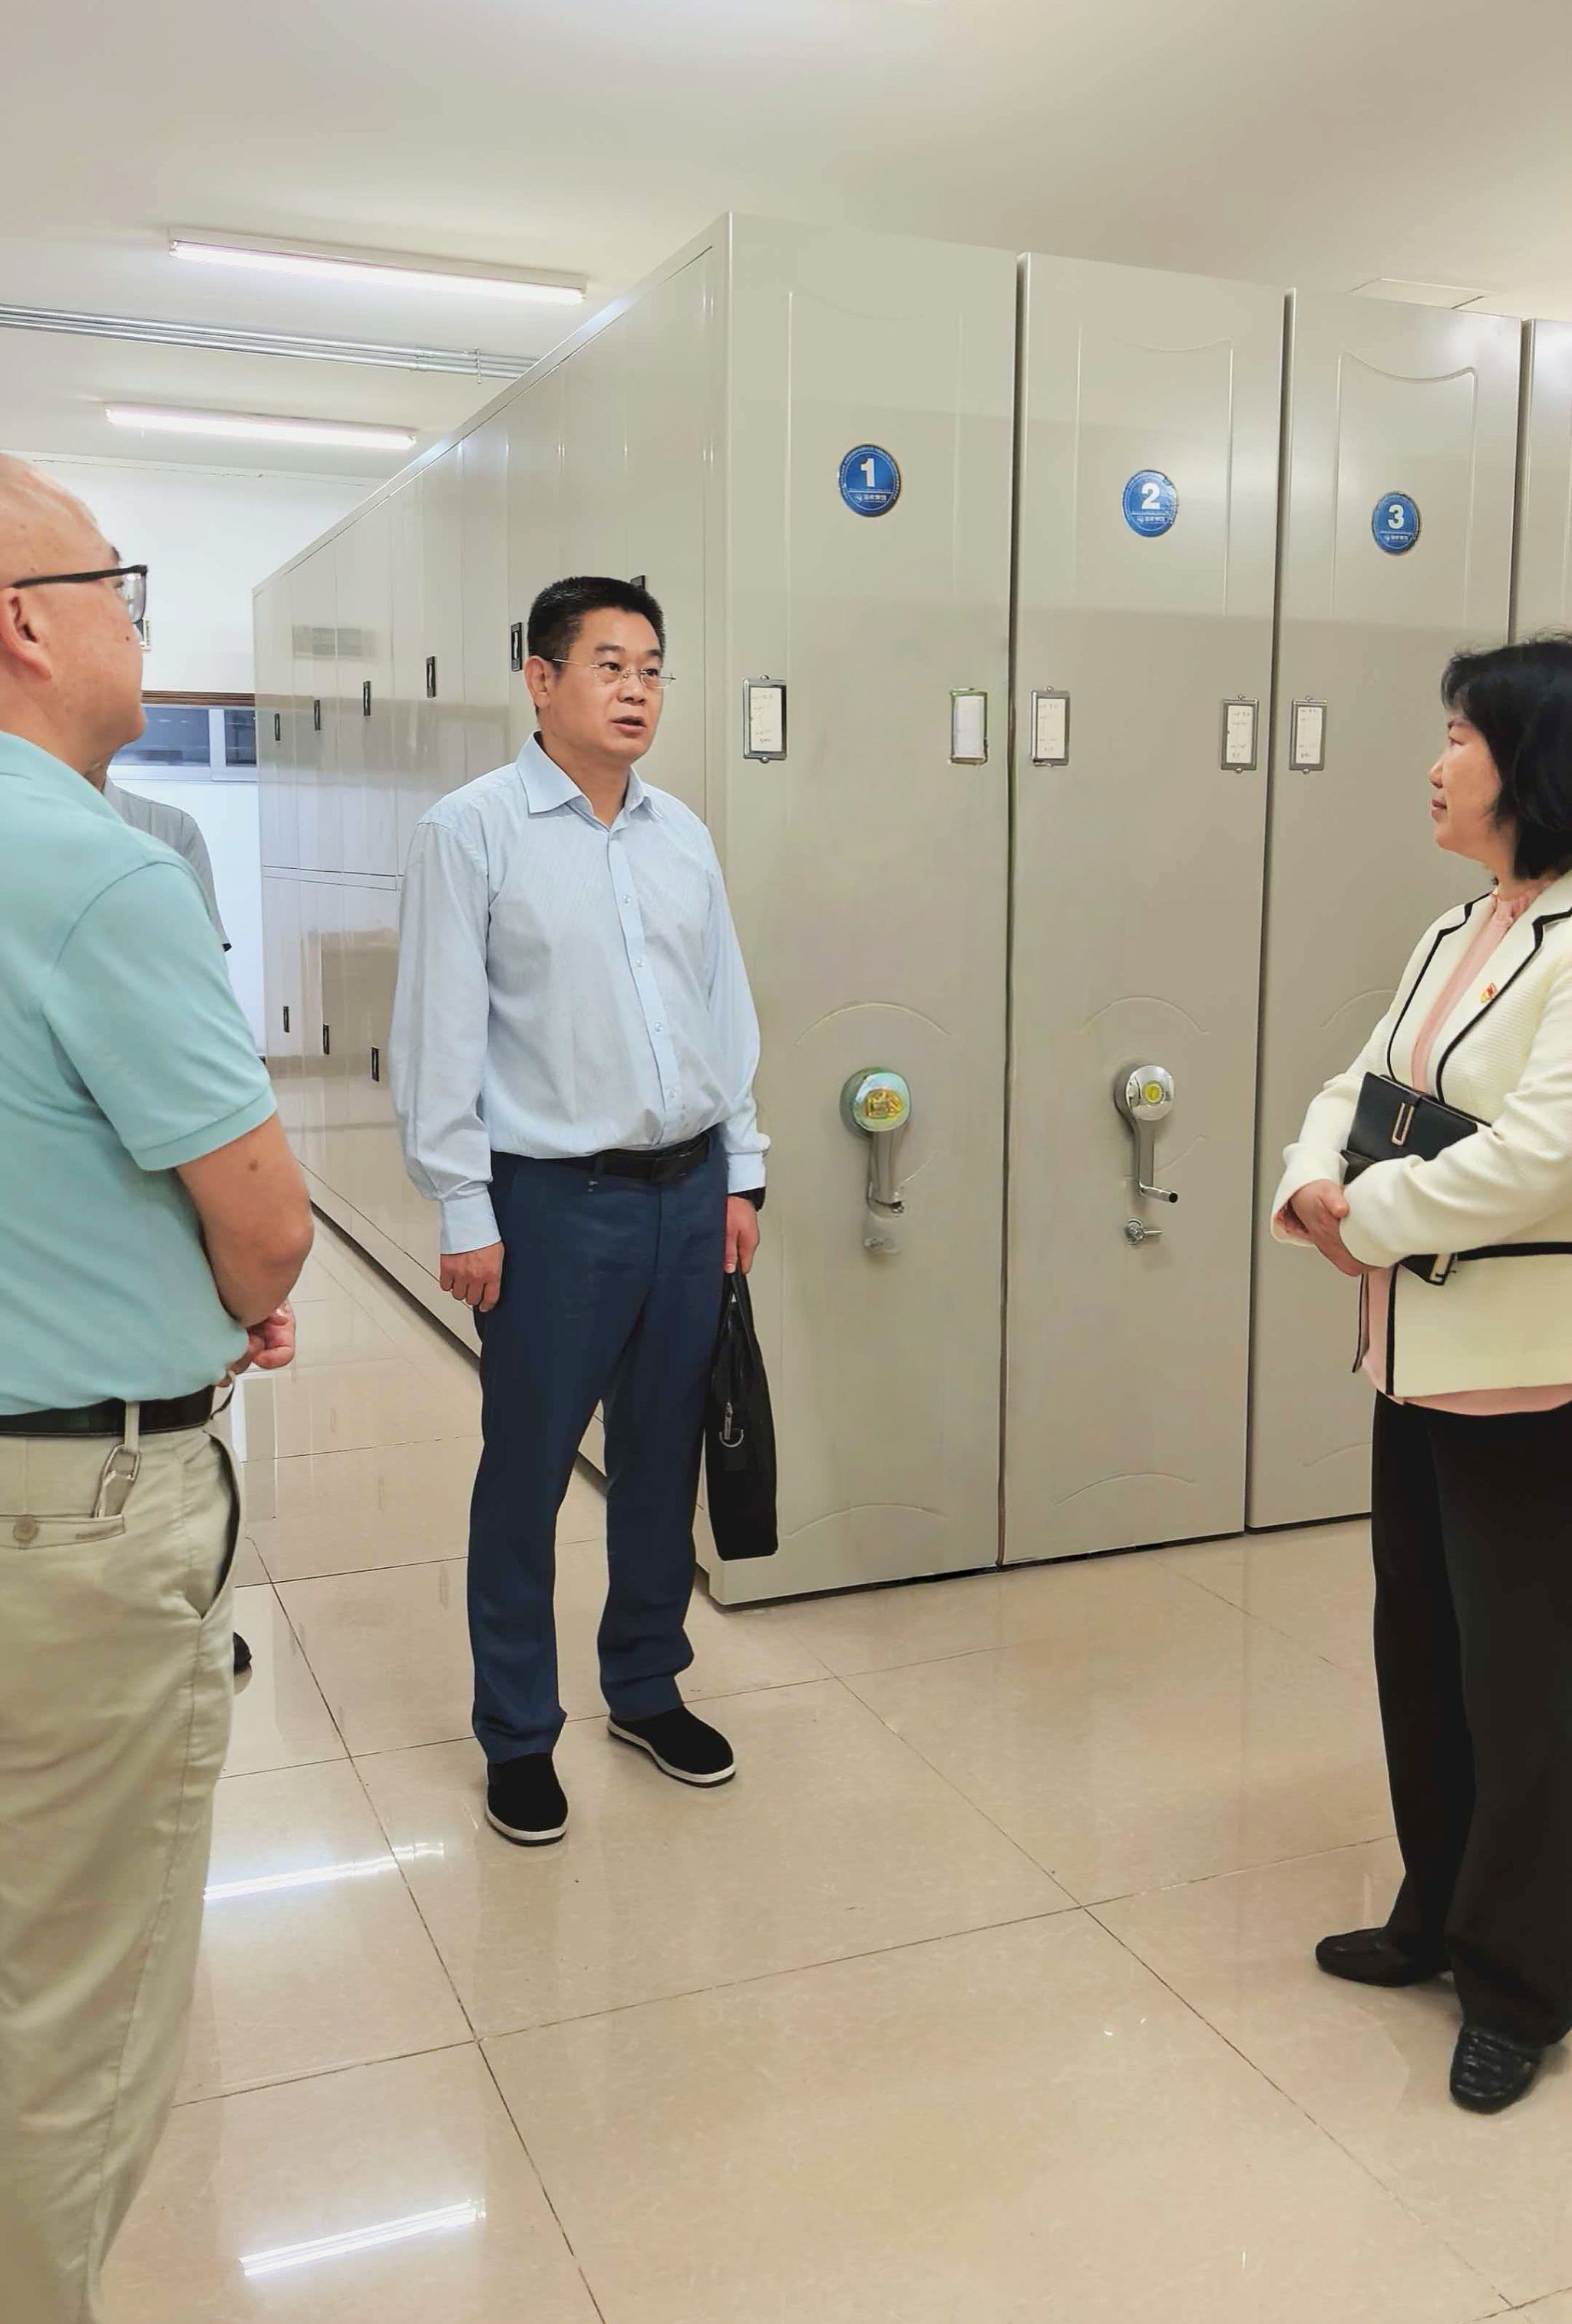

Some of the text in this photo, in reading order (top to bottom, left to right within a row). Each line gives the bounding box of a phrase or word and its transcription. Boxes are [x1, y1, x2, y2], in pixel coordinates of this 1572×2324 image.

[860, 458, 875, 487] 1
[1141, 483, 1160, 510] 2
[1388, 505, 1404, 529] 3
